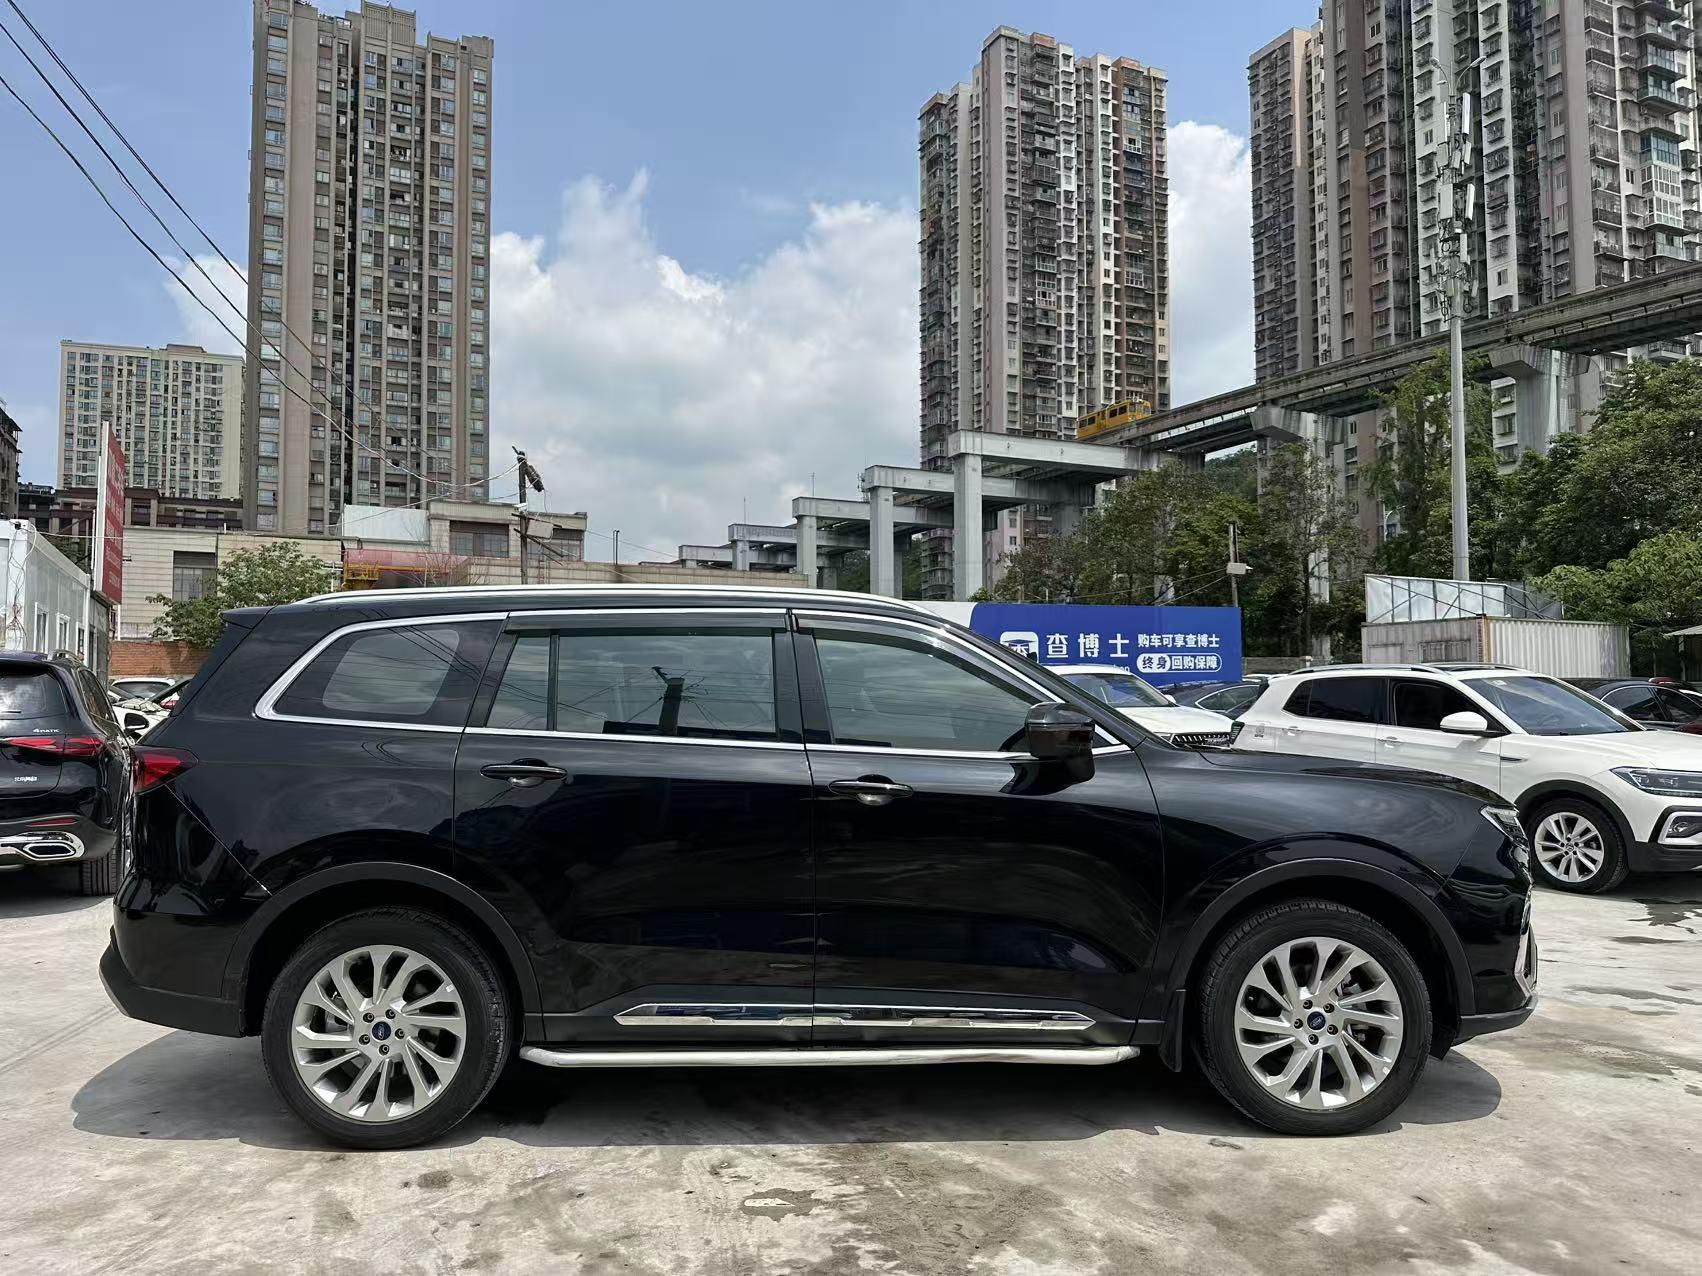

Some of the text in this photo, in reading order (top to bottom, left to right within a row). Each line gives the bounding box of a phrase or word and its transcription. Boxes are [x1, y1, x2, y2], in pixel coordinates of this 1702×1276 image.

[1046, 633, 1130, 658] 查博士
[1137, 633, 1220, 648] 购车可享查博士
